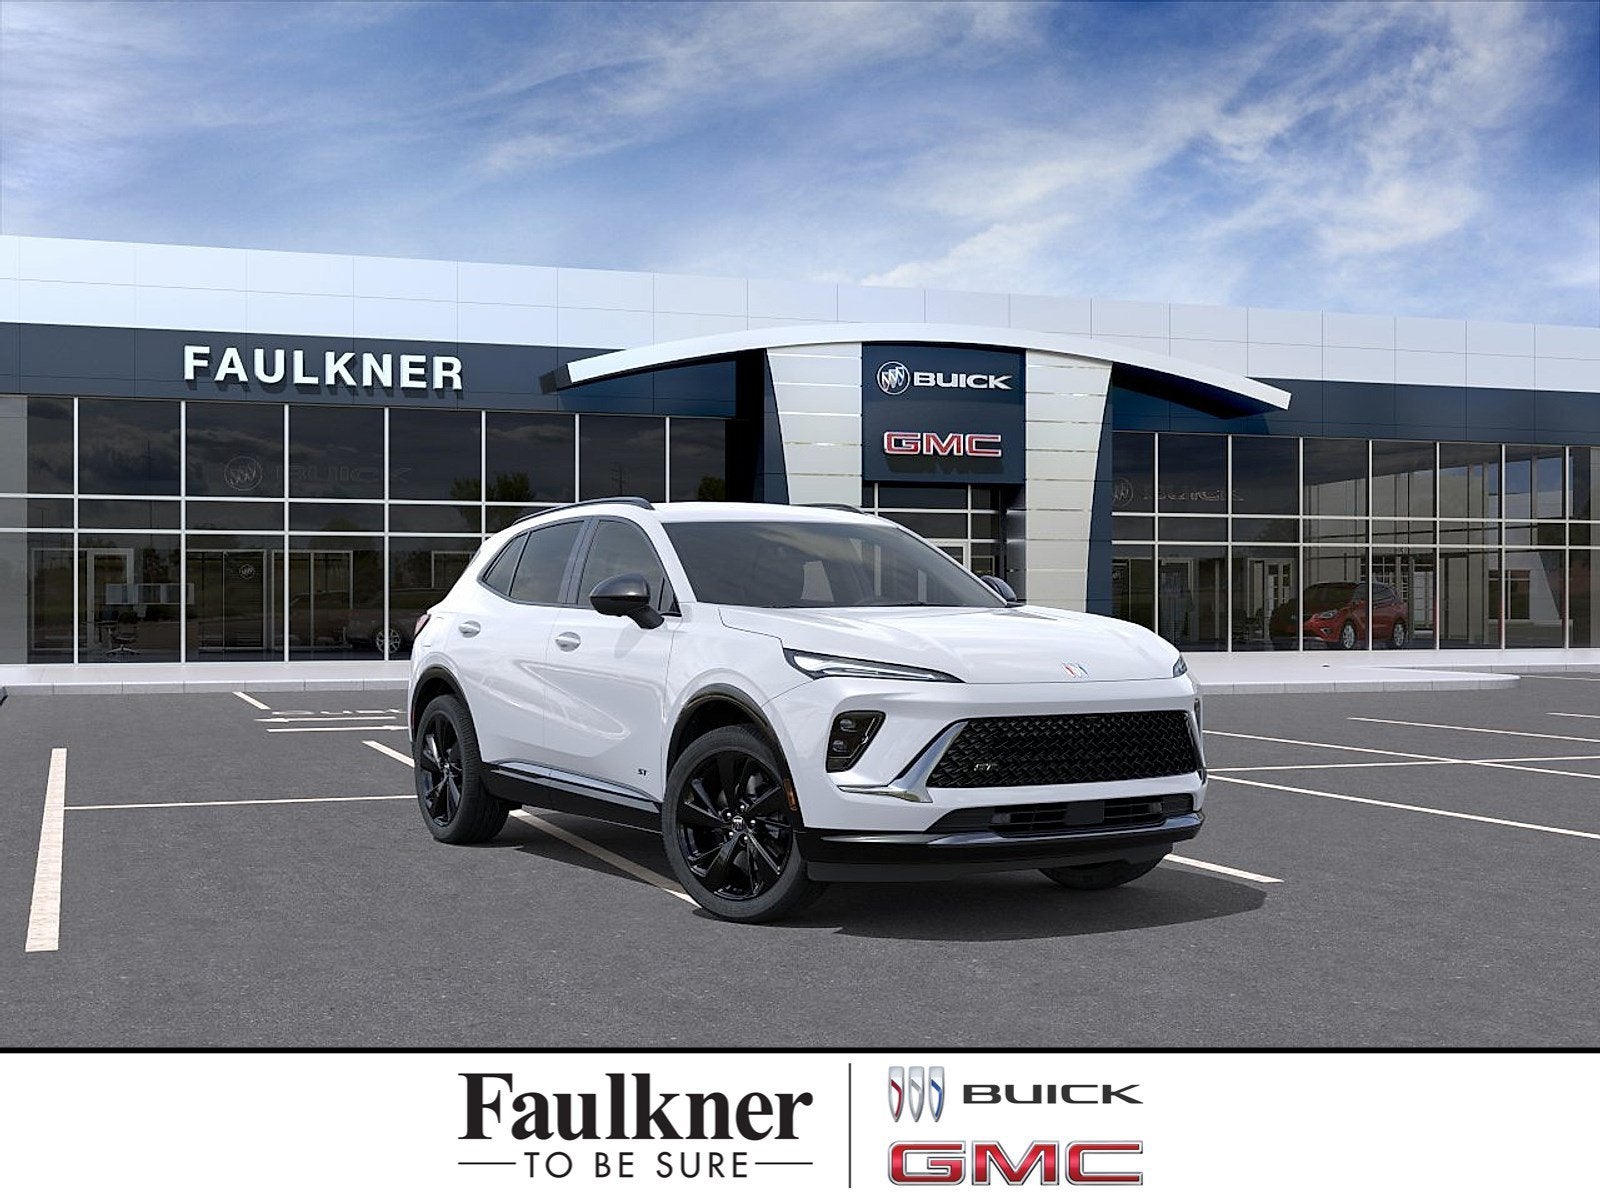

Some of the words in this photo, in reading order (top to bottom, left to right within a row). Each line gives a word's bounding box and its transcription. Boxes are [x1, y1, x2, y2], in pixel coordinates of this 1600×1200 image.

[183, 345, 463, 391] FAULKNER
[913, 372, 1012, 390] BUICK
[884, 431, 1002, 458] GMC
